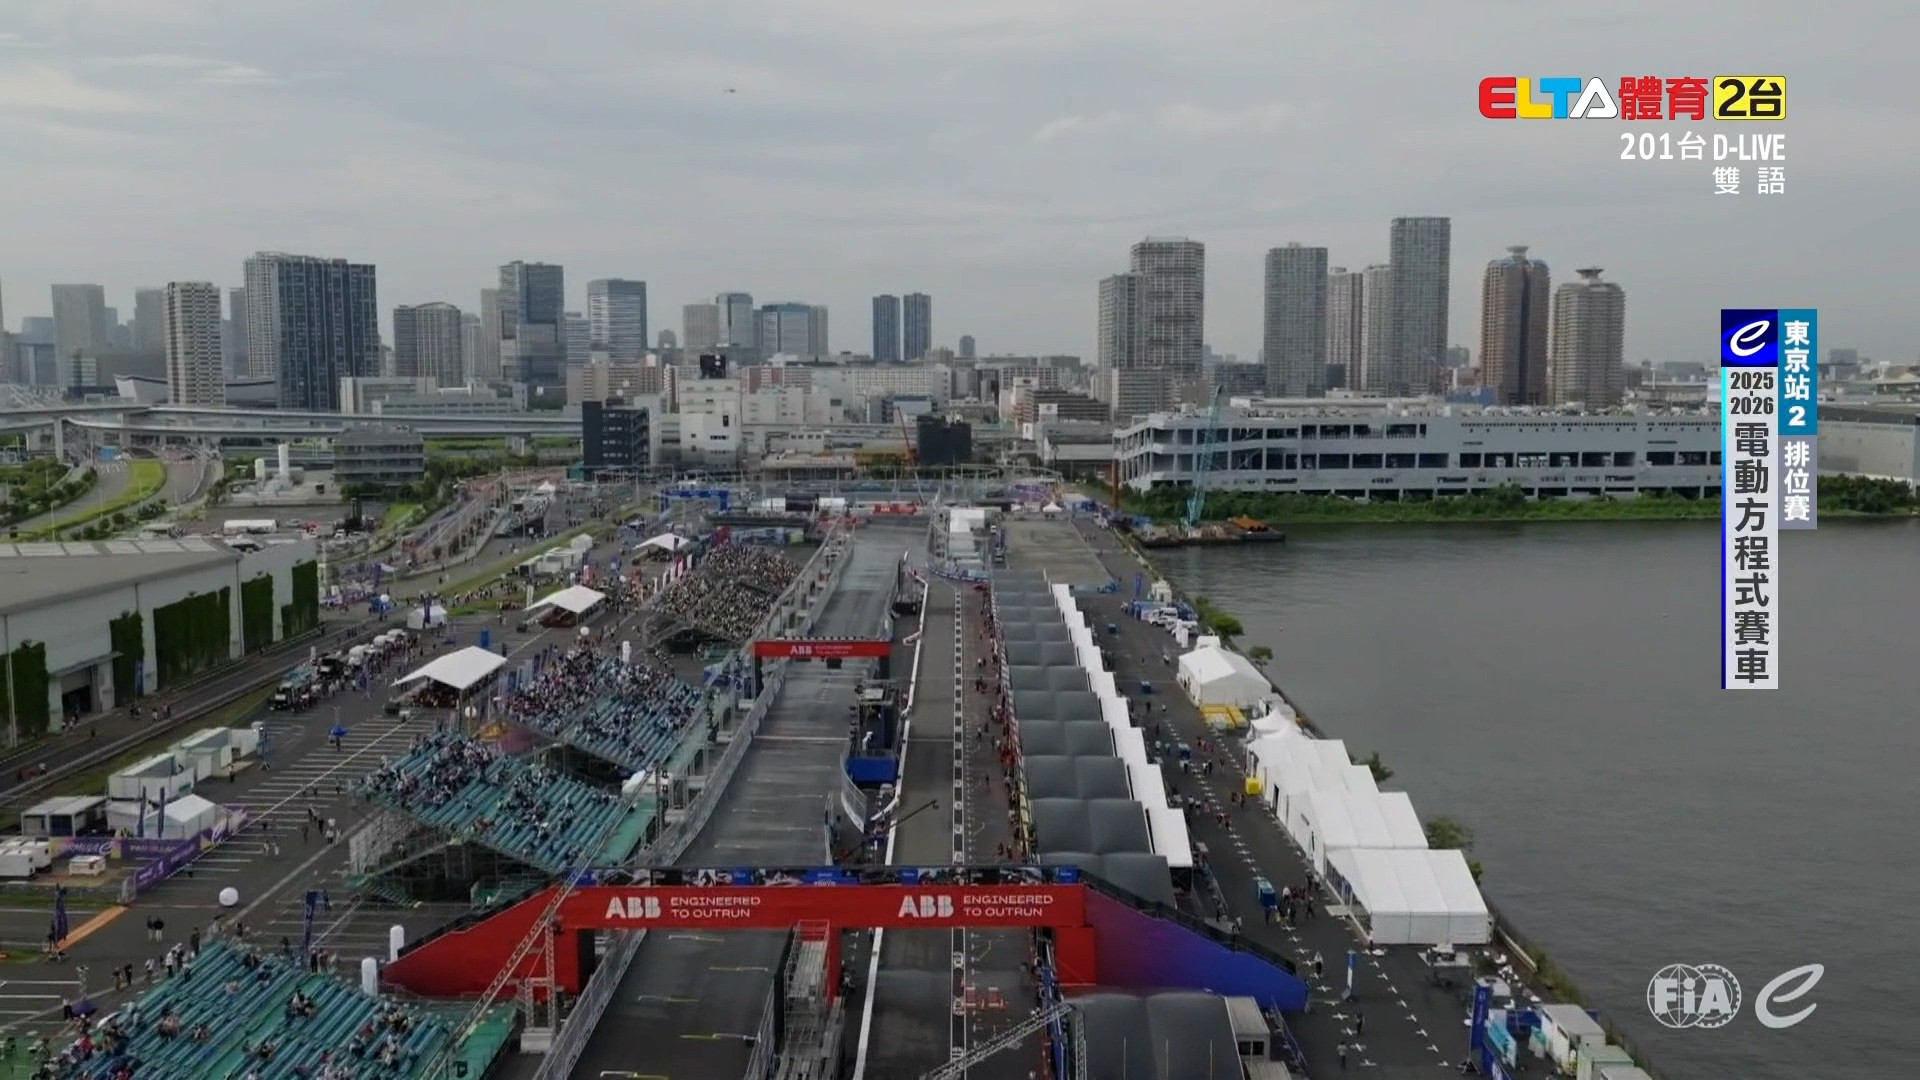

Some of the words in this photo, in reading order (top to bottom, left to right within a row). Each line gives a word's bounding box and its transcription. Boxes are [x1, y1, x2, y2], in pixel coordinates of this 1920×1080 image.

[790, 645, 812, 655] ABB
[670, 896, 761, 906] ENGINEERED
[963, 895, 1053, 905] ENGINEERED
[605, 897, 661, 919] ABB
[898, 895, 954, 918] ABB
[963, 906, 982, 917] TO
[985, 906, 1043, 917] OUTRUN
[671, 908, 689, 919] TO
[692, 908, 751, 919] OUTRUN
